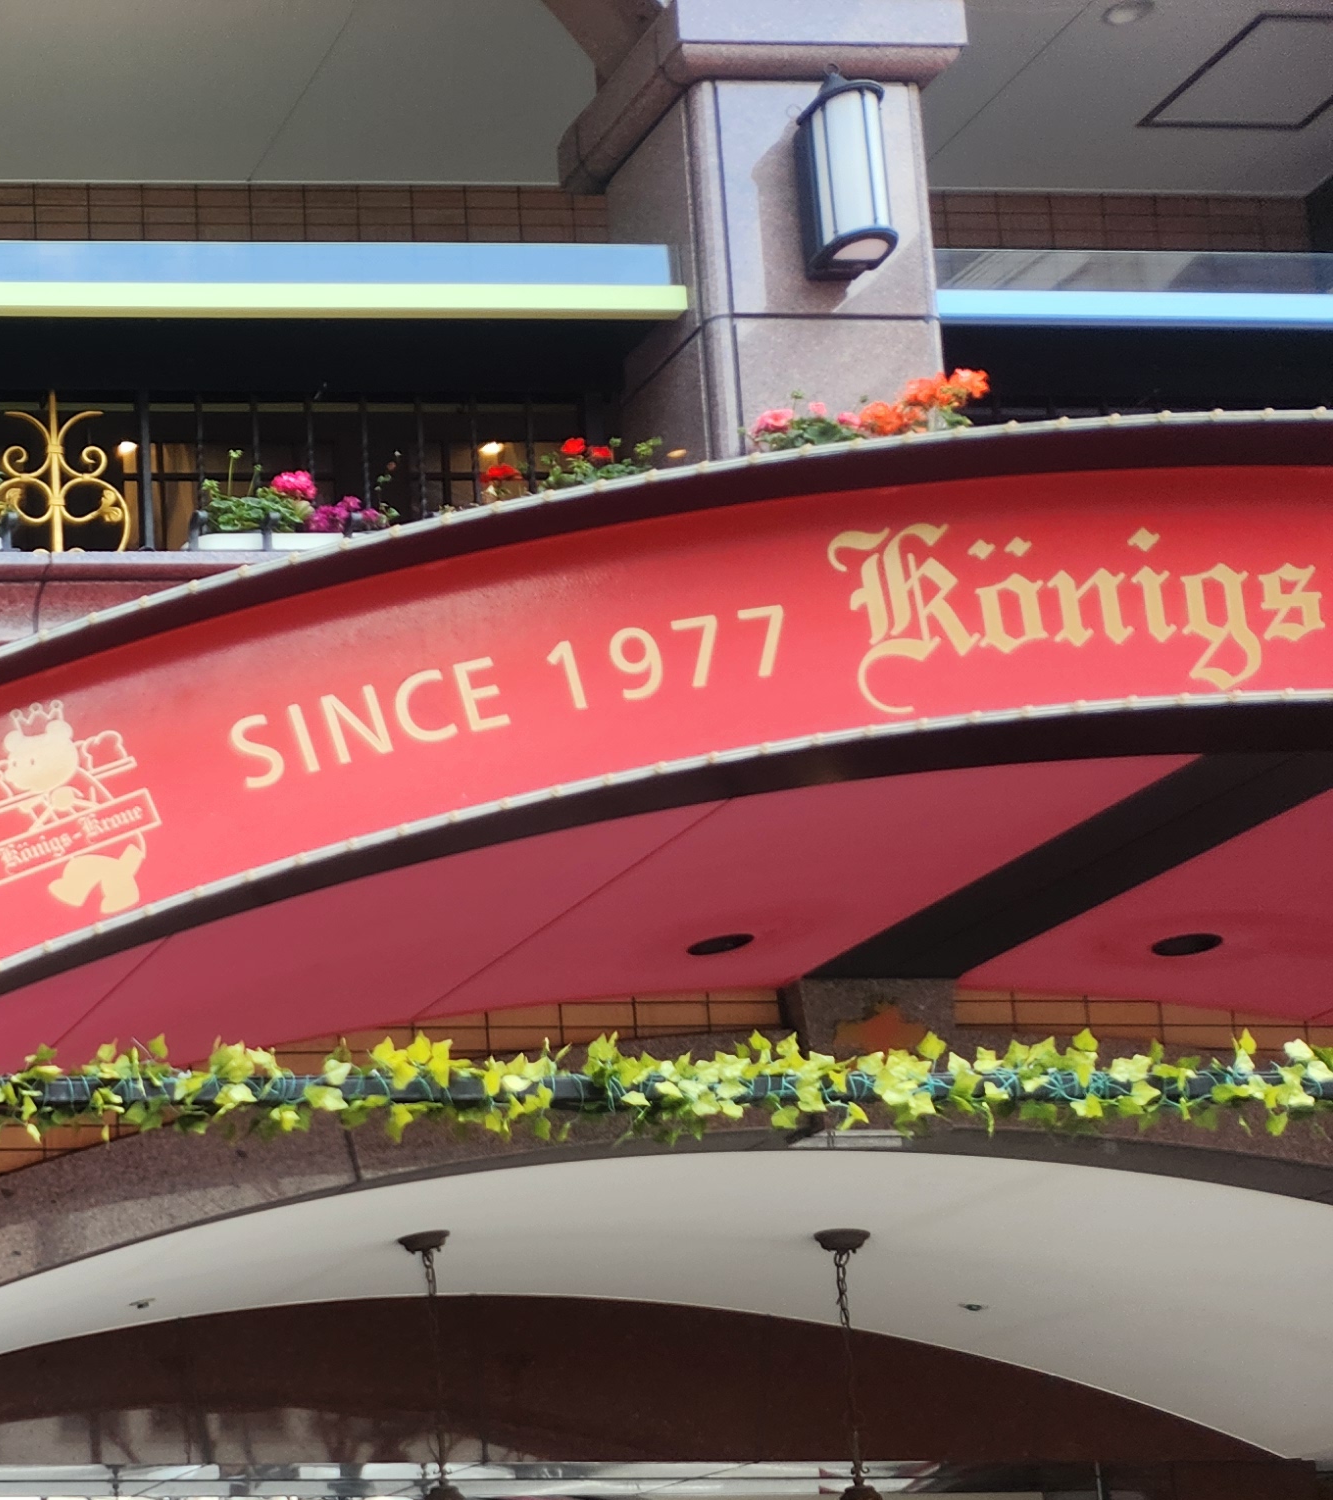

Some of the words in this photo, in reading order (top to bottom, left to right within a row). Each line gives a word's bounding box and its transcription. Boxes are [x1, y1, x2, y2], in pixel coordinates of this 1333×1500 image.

[229, 656, 511, 790] SINCE
[545, 604, 786, 711] 1977
[827, 521, 1326, 715] Königs
